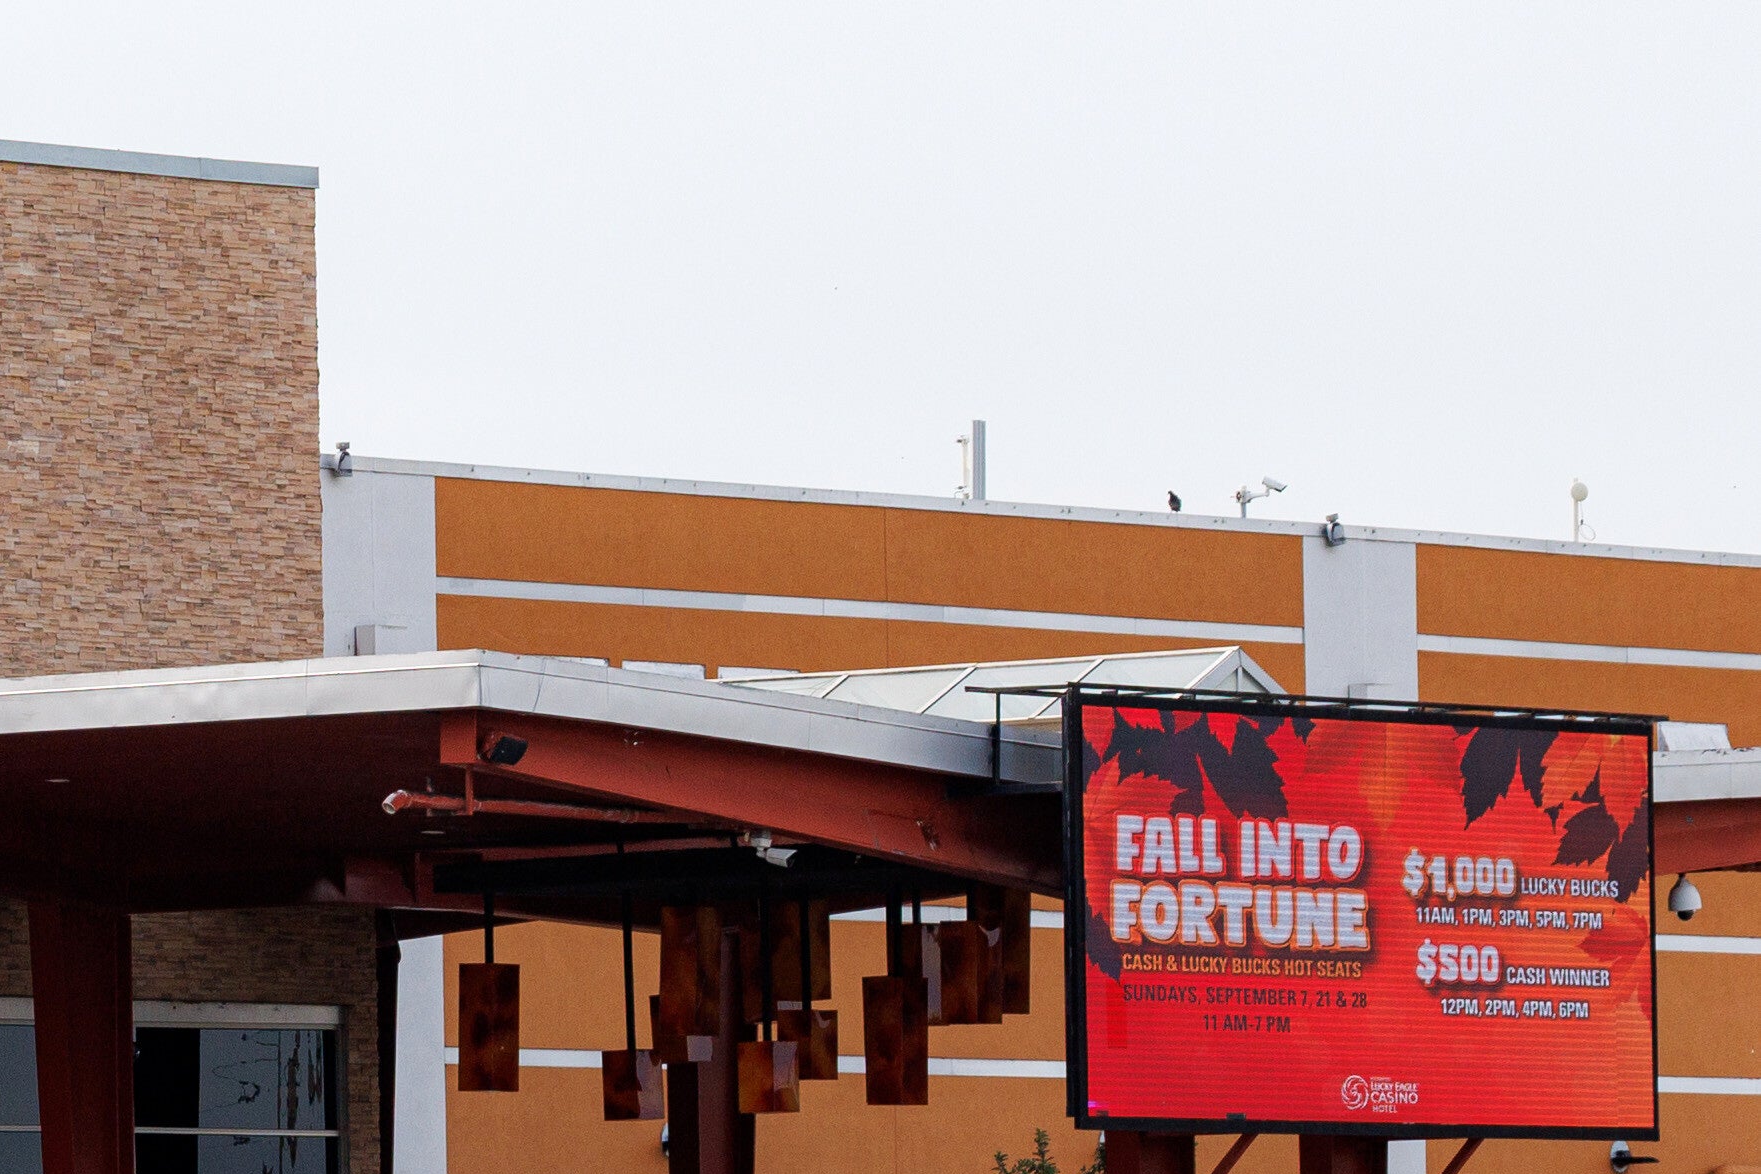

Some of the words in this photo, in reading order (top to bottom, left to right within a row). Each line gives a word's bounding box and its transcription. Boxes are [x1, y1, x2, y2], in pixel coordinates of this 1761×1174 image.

[1115, 813, 1225, 874] FALL
[1239, 819, 1362, 880] INTO
[1401, 847, 1517, 901] $1,000
[1520, 876, 1568, 896] LUCKY
[1570, 878, 1620, 898] BUCKS
[1111, 881, 1370, 949] FORTUNE
[1415, 906, 1459, 926] 11AM,
[1462, 908, 1497, 928] 1PM,
[1499, 909, 1533, 929] 3PM,
[1535, 910, 1570, 930] 5PM,
[1572, 911, 1603, 930] 7PM
[1121, 952, 1163, 972] CASH
[1166, 955, 1178, 972] &
[1181, 955, 1229, 974] LUCKY
[1231, 957, 1281, 976] BUCKS
[1284, 958, 1314, 977] HOT
[1316, 960, 1362, 978] SEATS
[1415, 937, 1501, 985] $500
[1505, 966, 1547, 985] CASH
[1549, 968, 1611, 987] WINNER
[1122, 983, 1201, 1005] SUNDAYS,
[1205, 986, 1297, 1007] SEPTEMBER
[1315, 991, 1331, 1007] 21
[1336, 991, 1347, 1008] &
[1351, 991, 1368, 1009] 28
[1440, 997, 1483, 1017] 12PM,
[1485, 999, 1520, 1019] 2PM,
[1522, 1000, 1557, 1019] 4PM,
[1558, 1001, 1589, 1018] 6PM
[1202, 1014, 1218, 1032] 11
[1266, 1016, 1291, 1034] PM
[1370, 1091, 1419, 1104] CASINO
